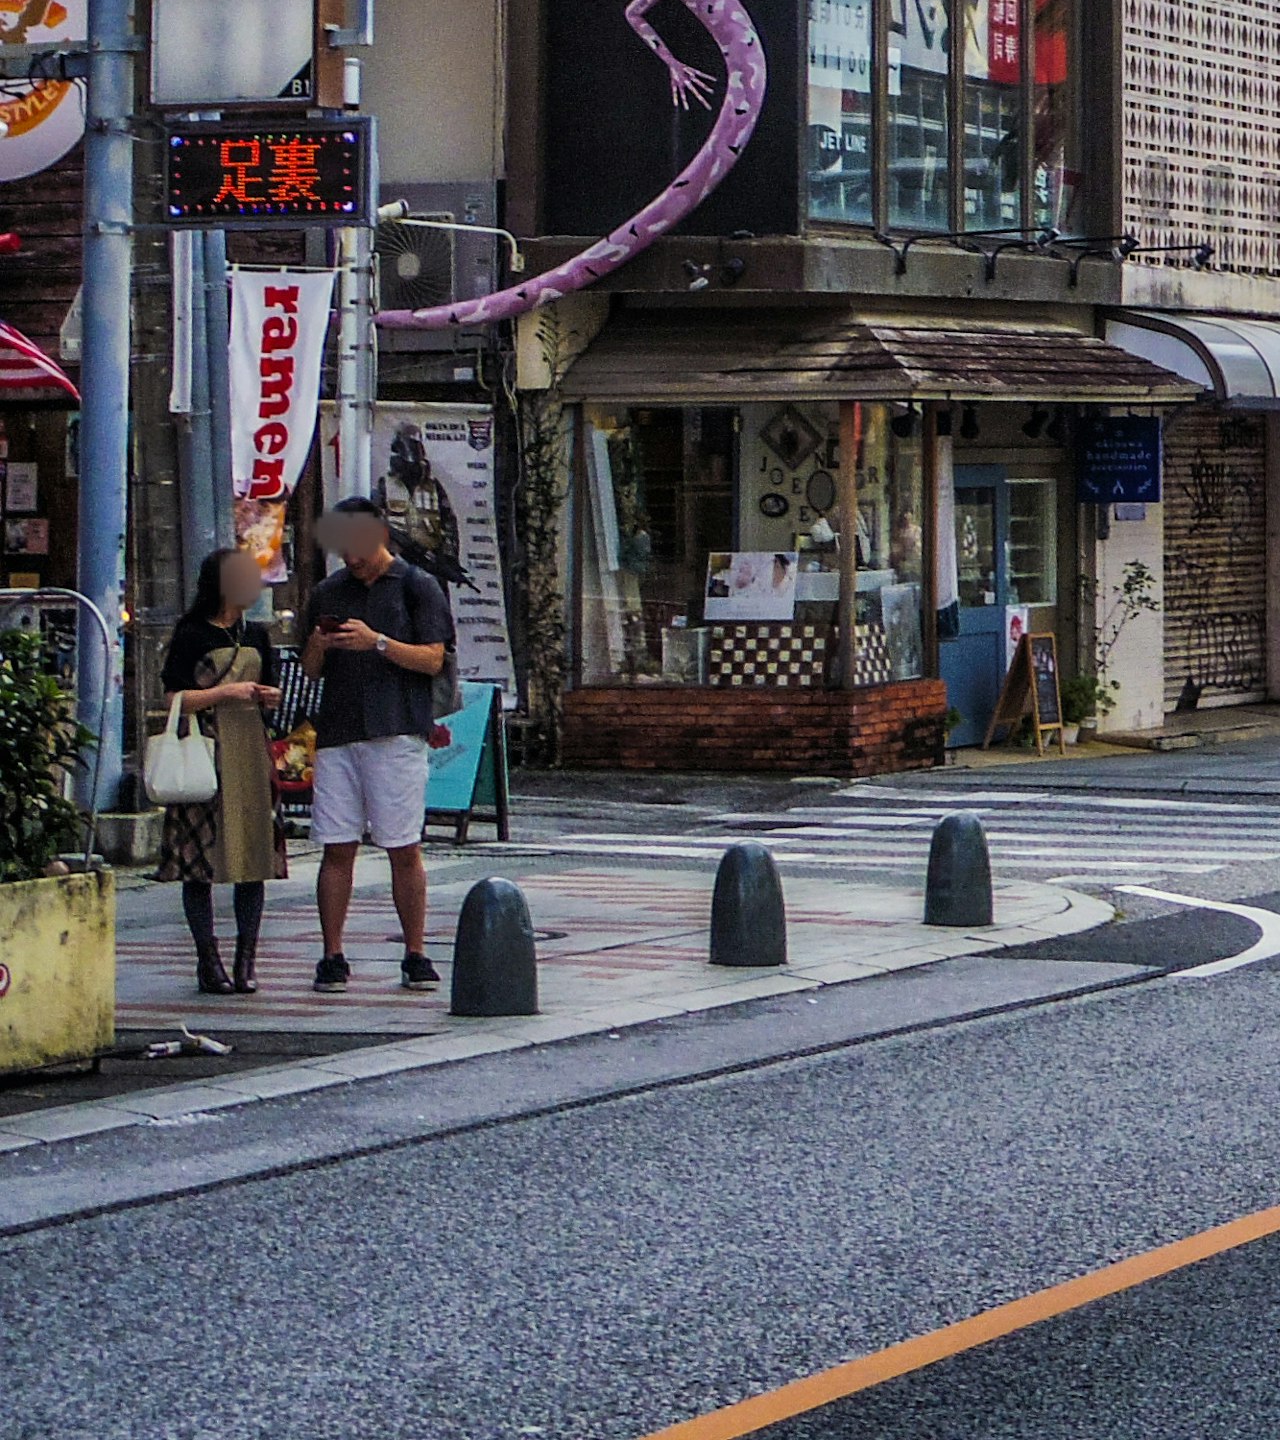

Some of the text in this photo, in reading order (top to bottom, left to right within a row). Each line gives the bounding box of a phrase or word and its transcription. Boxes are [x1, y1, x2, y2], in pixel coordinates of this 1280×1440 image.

[292, 79, 310, 95] B1
[213, 138, 321, 203] 足裏
[249, 286, 300, 501] ramen
